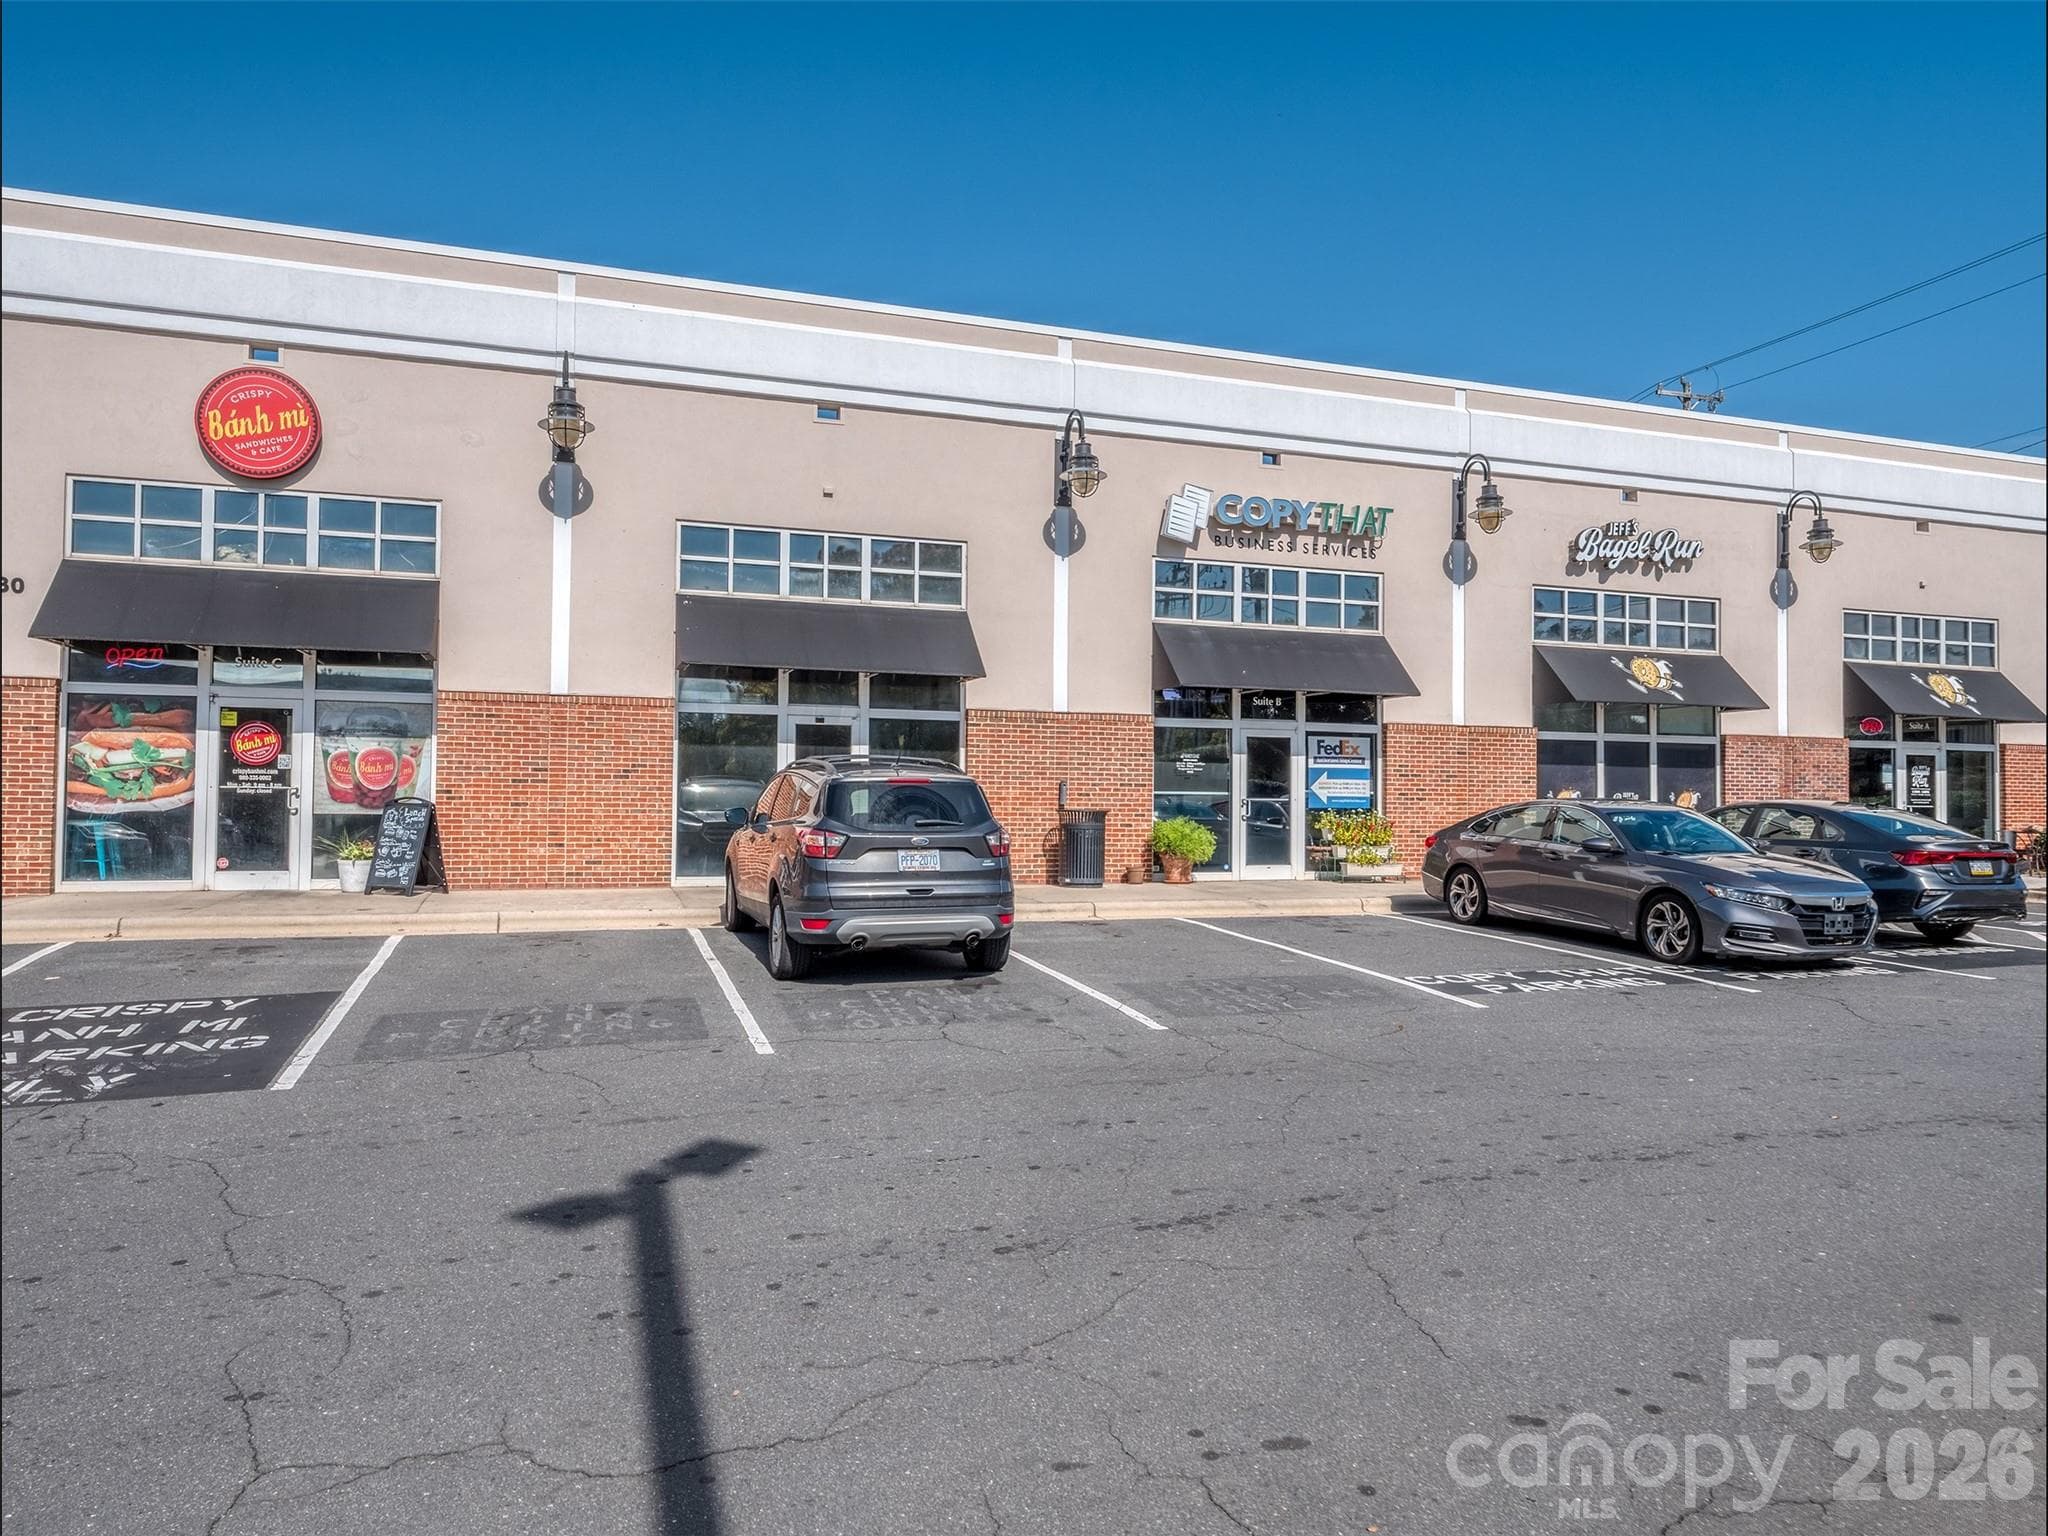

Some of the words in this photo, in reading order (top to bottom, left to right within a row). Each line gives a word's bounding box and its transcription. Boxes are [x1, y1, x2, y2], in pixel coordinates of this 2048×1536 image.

[230, 389, 273, 404] CRISPY
[207, 404, 274, 441] Bánh
[234, 435, 293, 450] SANDWICHES
[1608, 520, 1639, 536] JEFF'S
[1214, 534, 1294, 553] BUSINESS
[1302, 542, 1378, 560] SERVICES
[1575, 526, 1653, 570] Bagel
[1652, 528, 1704, 567] Run
[235, 656, 268, 669] Suite
[271, 657, 282, 669] C
[1252, 696, 1274, 706] Suite
[1275, 697, 1282, 706] B
[1317, 739, 1361, 756] FedEx
[900, 854, 938, 866] PFP-2070
[1404, 971, 1527, 985] COPY
[1471, 976, 1667, 994] PARKING
[8, 998, 259, 1023] CRISPY
[178, 1016, 248, 1034] MI
